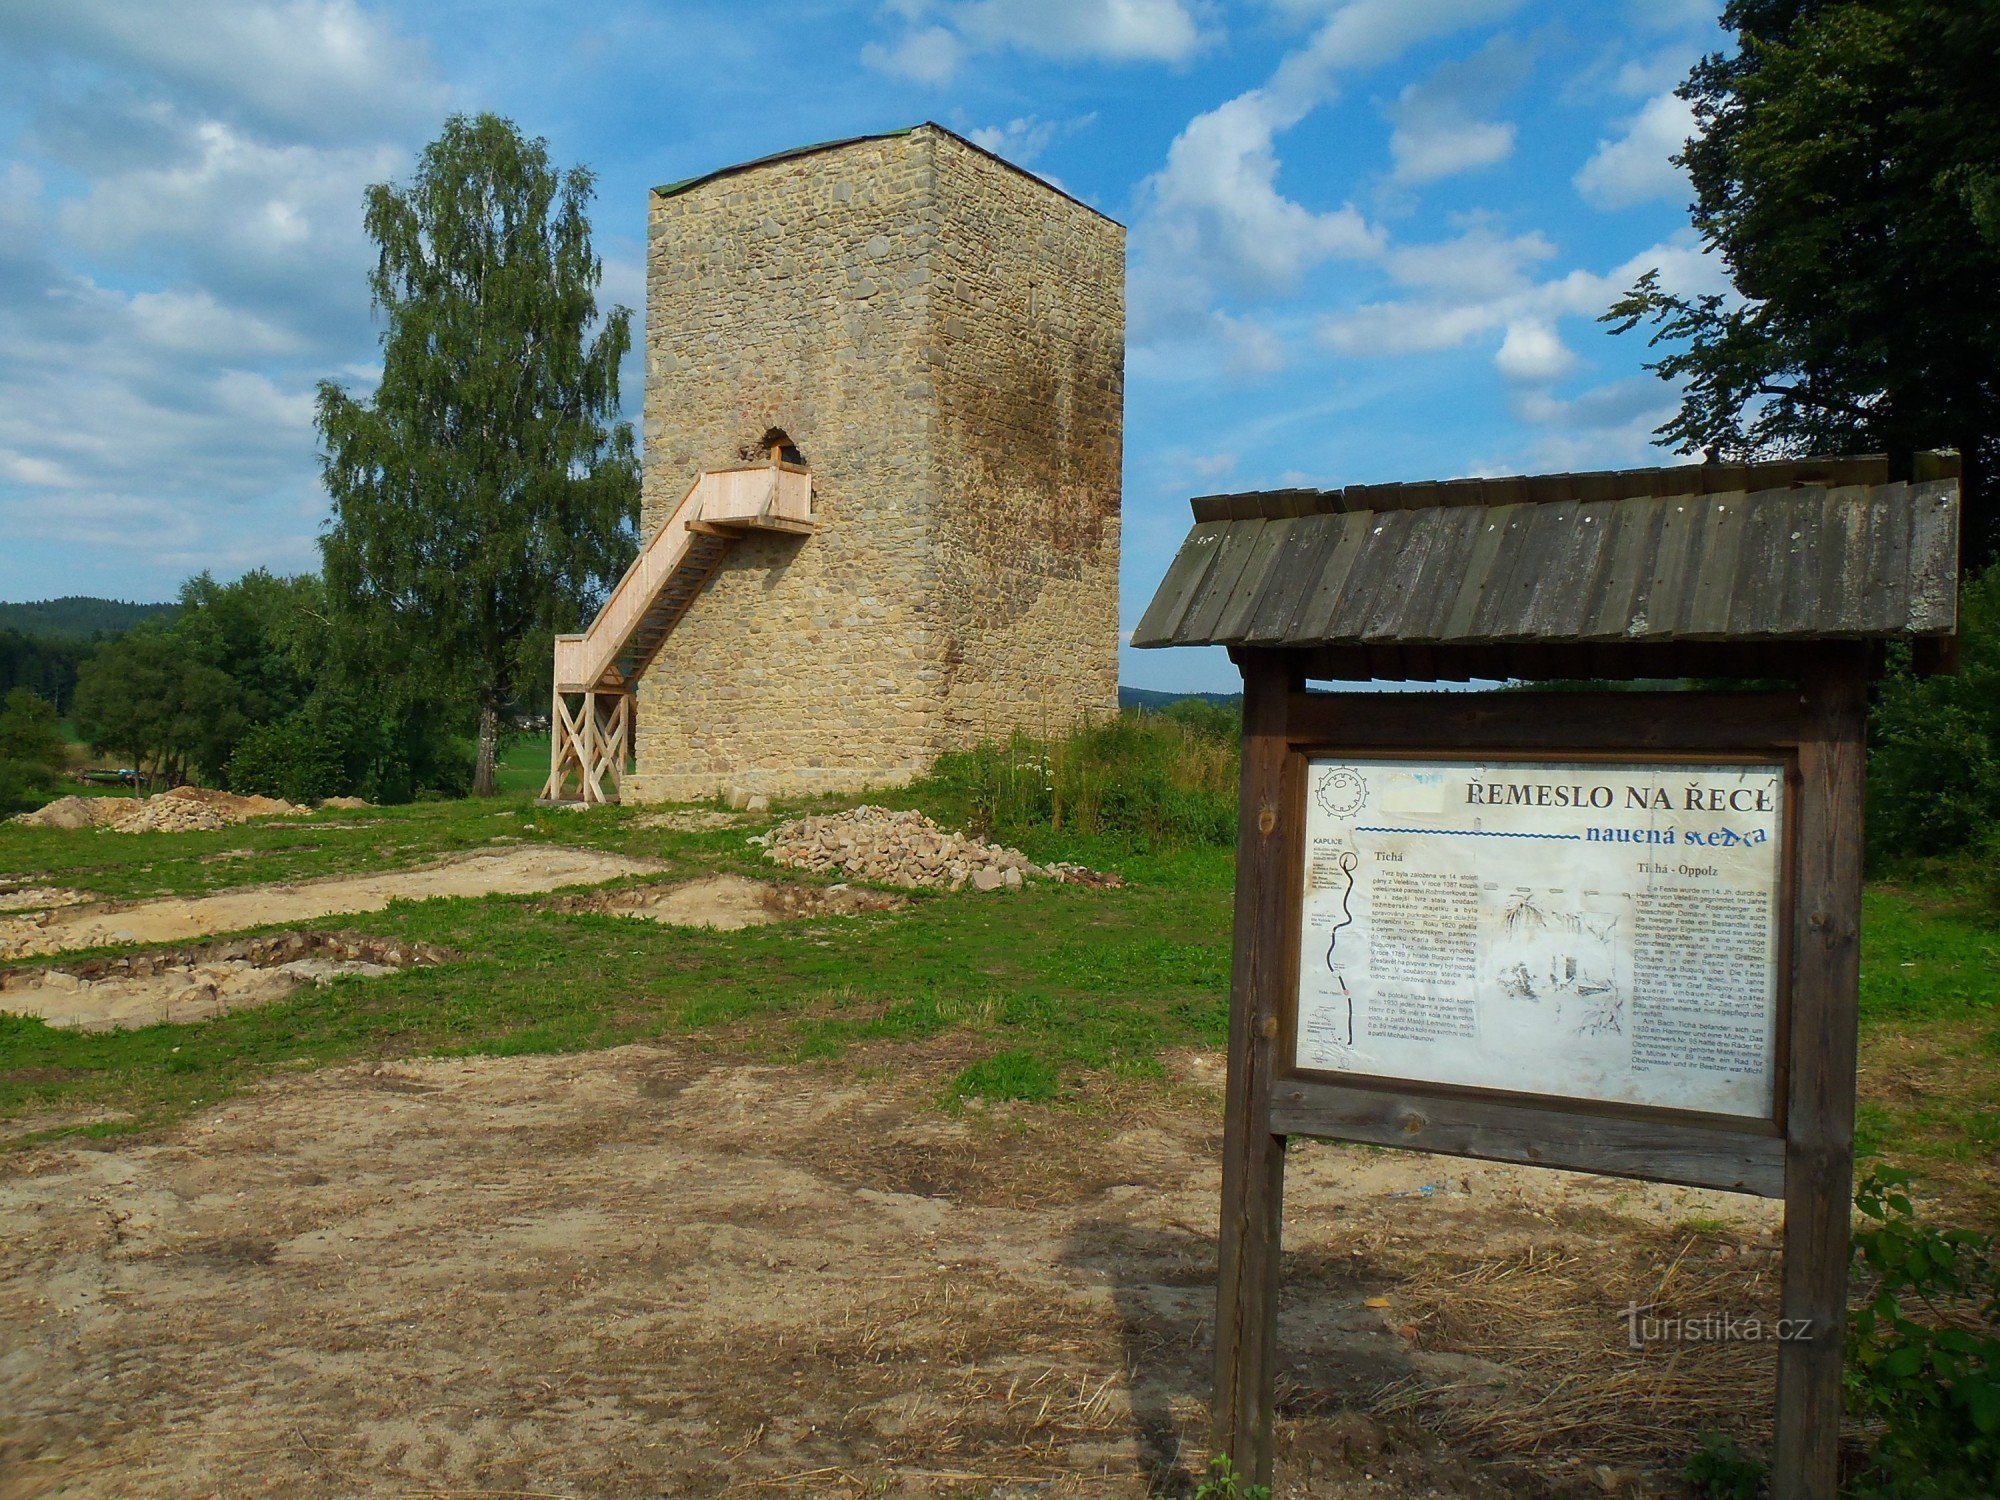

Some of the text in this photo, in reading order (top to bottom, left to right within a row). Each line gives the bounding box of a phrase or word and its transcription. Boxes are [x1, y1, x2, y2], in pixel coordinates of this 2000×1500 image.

[1466, 776, 1613, 808] ŘEMESLO
[1624, 785, 1674, 810] NA
[1374, 852, 1403, 862] Tichá
[1396, 870, 1408, 878] byla
[1637, 862, 1668, 873] Tihá
[1679, 865, 1718, 877] Oppolz
[1463, 906, 1478, 914] byla
